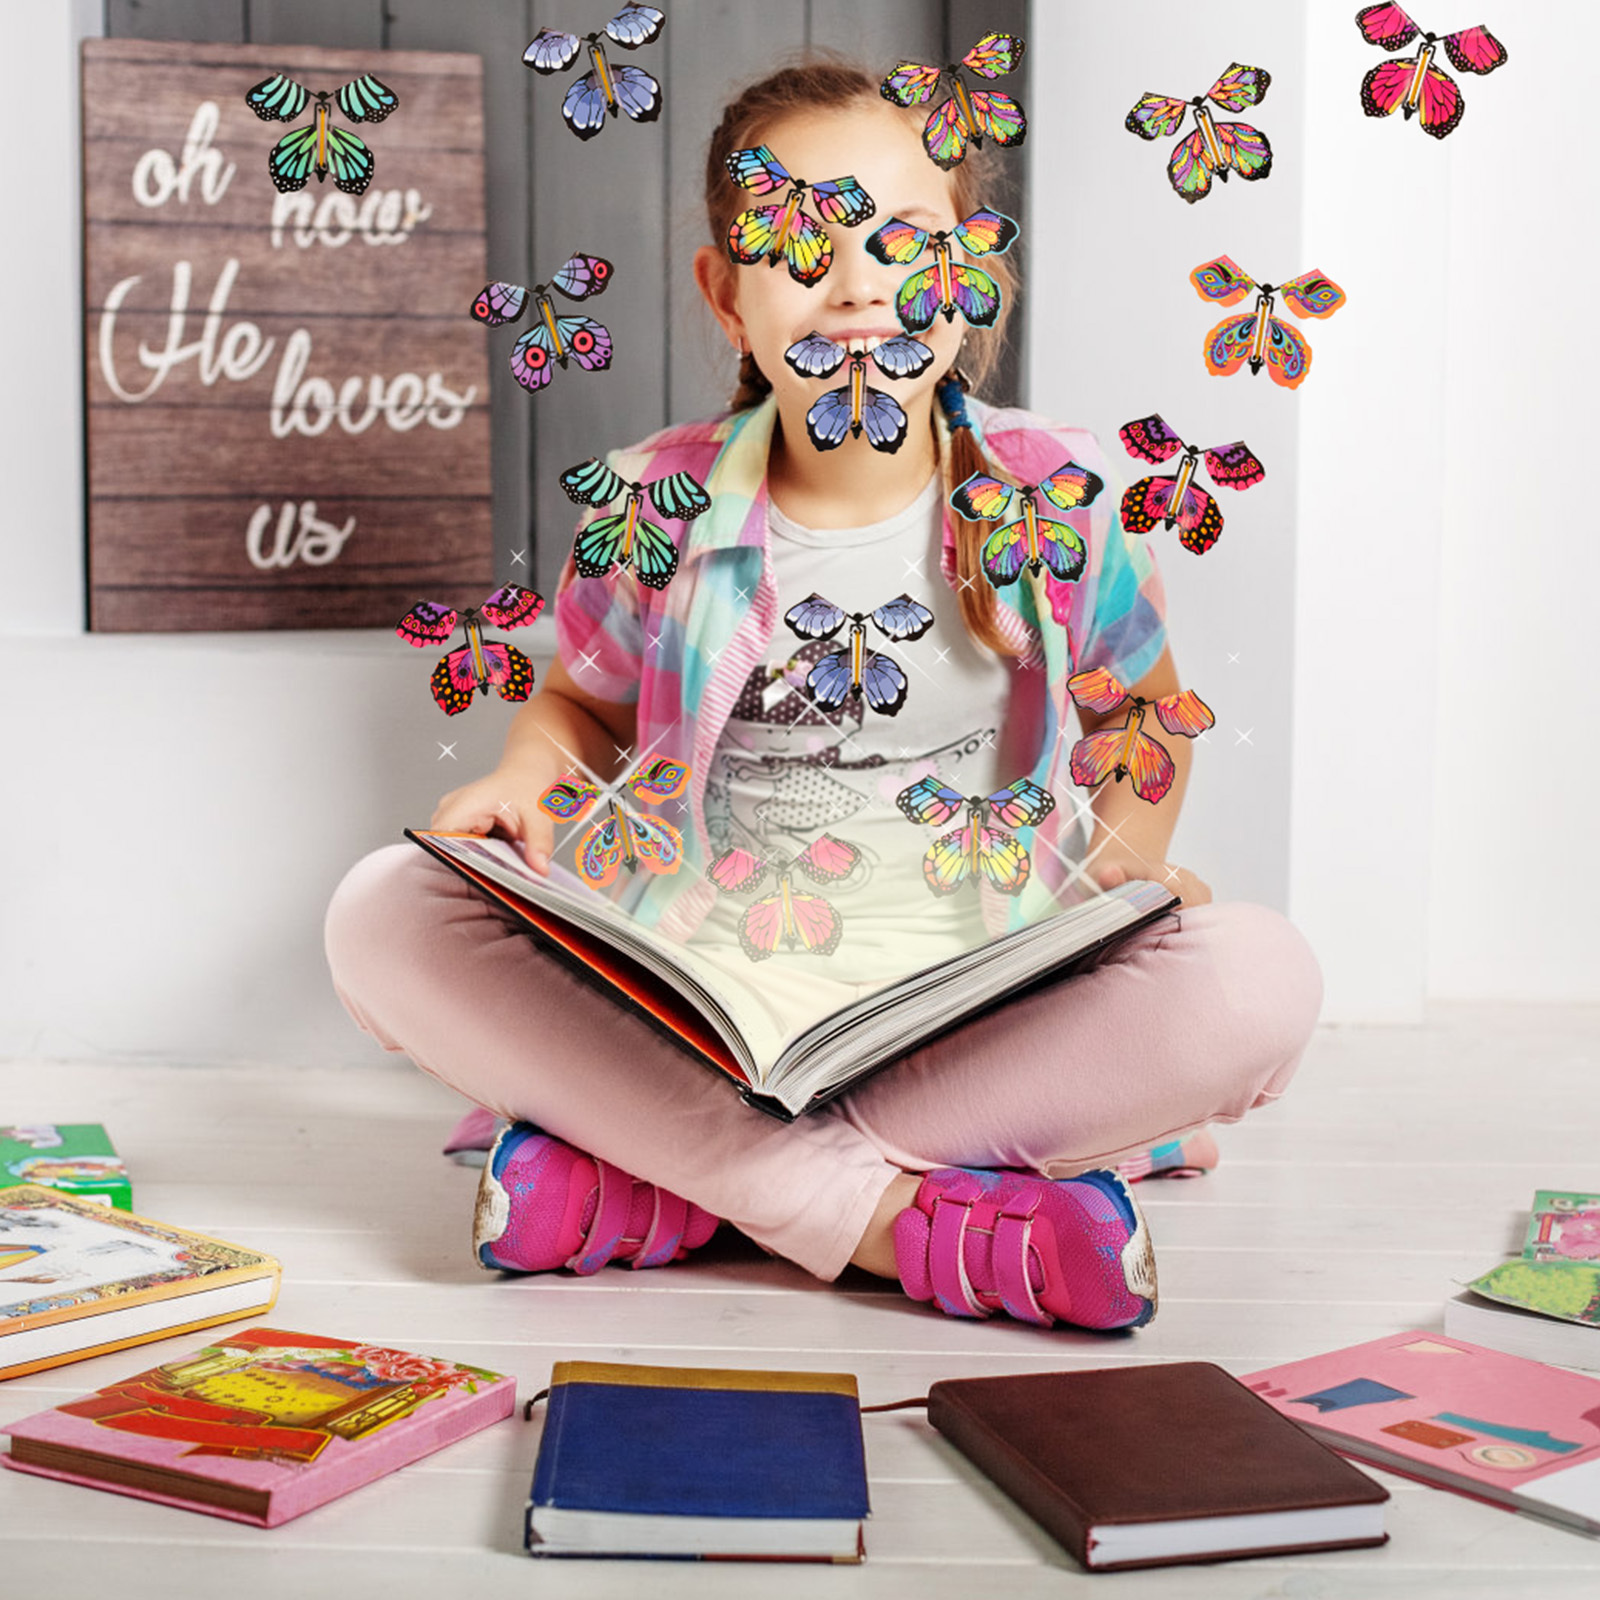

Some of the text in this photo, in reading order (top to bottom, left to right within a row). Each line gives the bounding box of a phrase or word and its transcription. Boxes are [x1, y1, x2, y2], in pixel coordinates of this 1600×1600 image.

[132, 101, 236, 208] oh
[99, 259, 274, 403] He
[269, 328, 477, 438] loves
[245, 502, 356, 569] us
